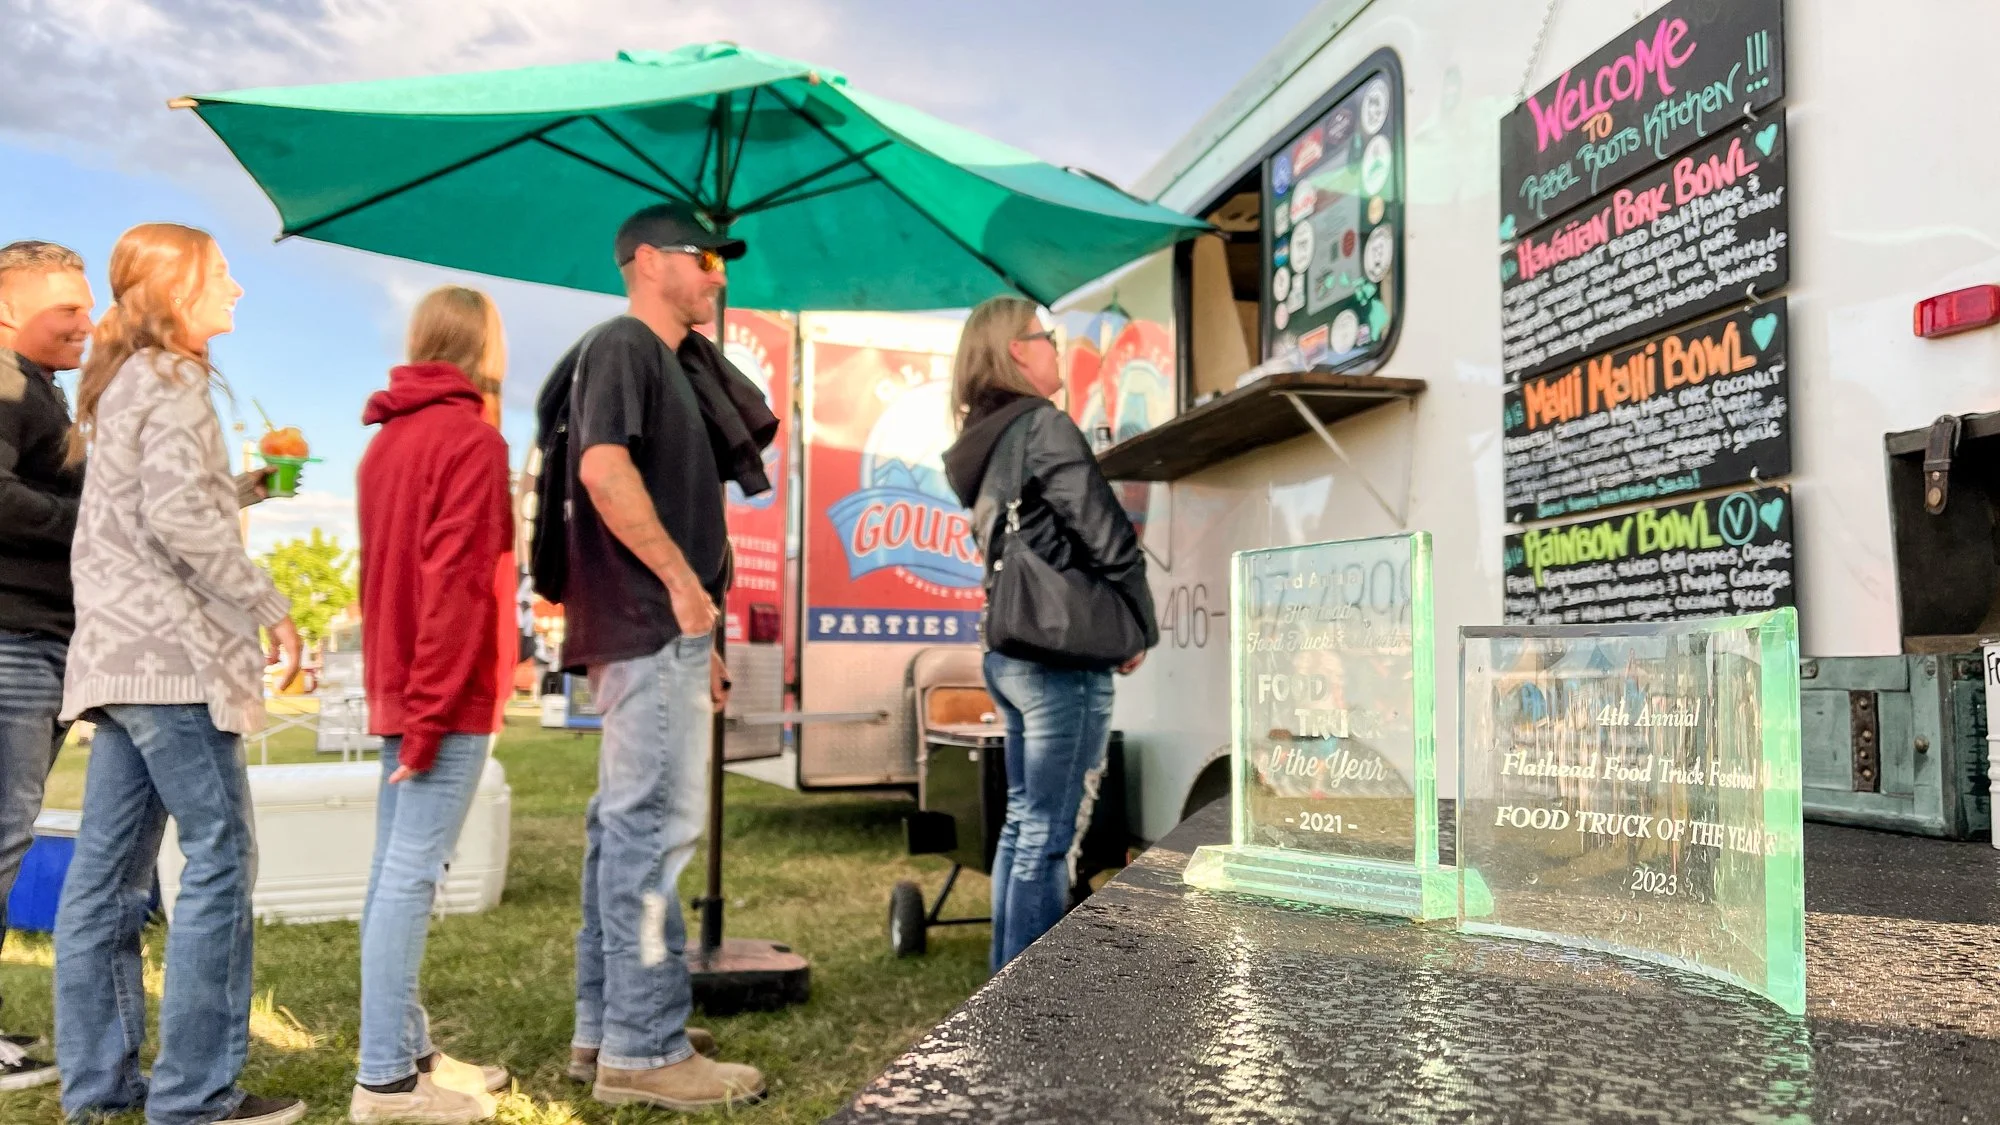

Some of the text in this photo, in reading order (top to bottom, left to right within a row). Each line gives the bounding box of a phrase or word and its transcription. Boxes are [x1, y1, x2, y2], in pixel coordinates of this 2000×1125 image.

[1581, 111, 1613, 143] TO
[818, 614, 958, 637] PARTIES
[1258, 674, 1329, 704] FOOD
[1596, 697, 1700, 728] 4th Annual
[1285, 749, 1321, 777] the
[1325, 749, 1388, 788] Year
[1501, 751, 1757, 790] Flathead Food Truck Festival
[1300, 812, 1342, 834] 2021
[1495, 806, 1762, 857] FOOD TRUCK OF THE YEAR
[1631, 868, 1677, 896] 2023
